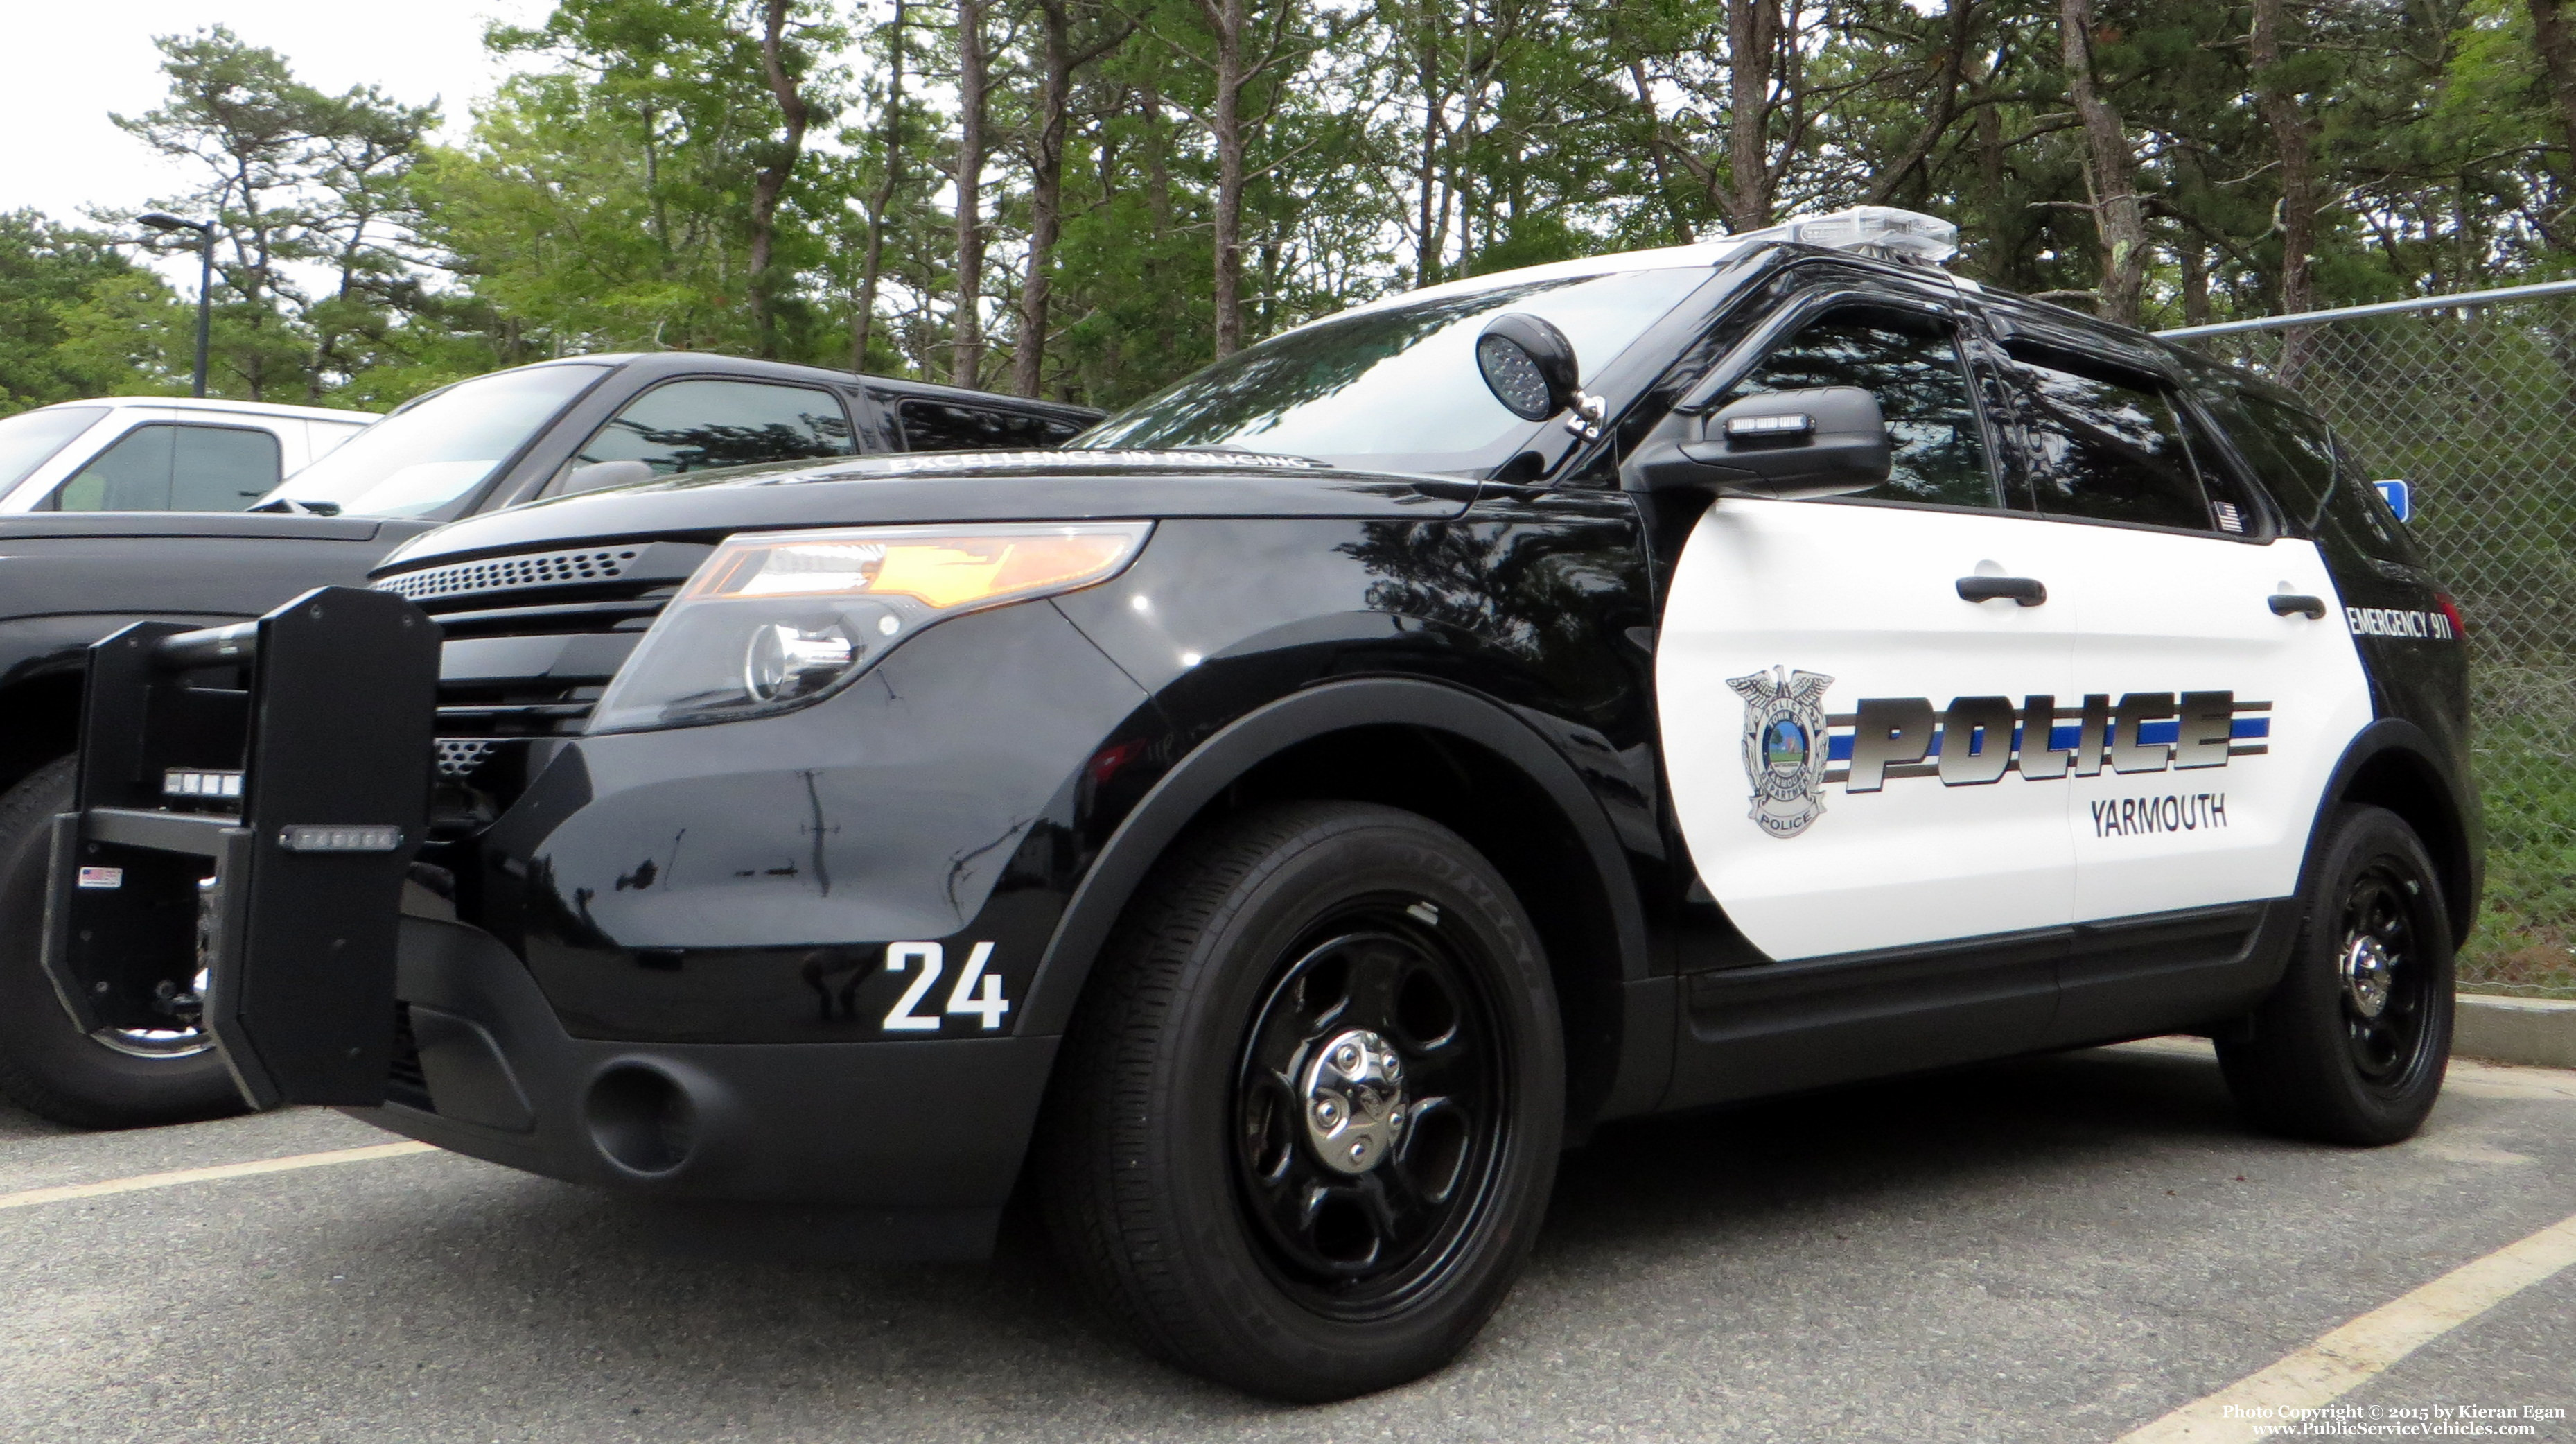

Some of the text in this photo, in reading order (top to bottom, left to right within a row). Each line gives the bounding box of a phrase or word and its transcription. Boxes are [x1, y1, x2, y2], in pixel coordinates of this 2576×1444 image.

[889, 451, 1311, 471] EXCELLENCE IN POLICING
[2346, 607, 2453, 639] EMERGENCY 911
[1765, 699, 1803, 717] POLICE
[1768, 711, 1803, 729] TOWN OF
[1846, 690, 2234, 794] POLICE
[1761, 767, 1812, 799] DEPARTMENT
[1760, 810, 1812, 830] POLICE
[2092, 792, 2227, 837] YARMOUTH
[883, 940, 1010, 1031] 24
